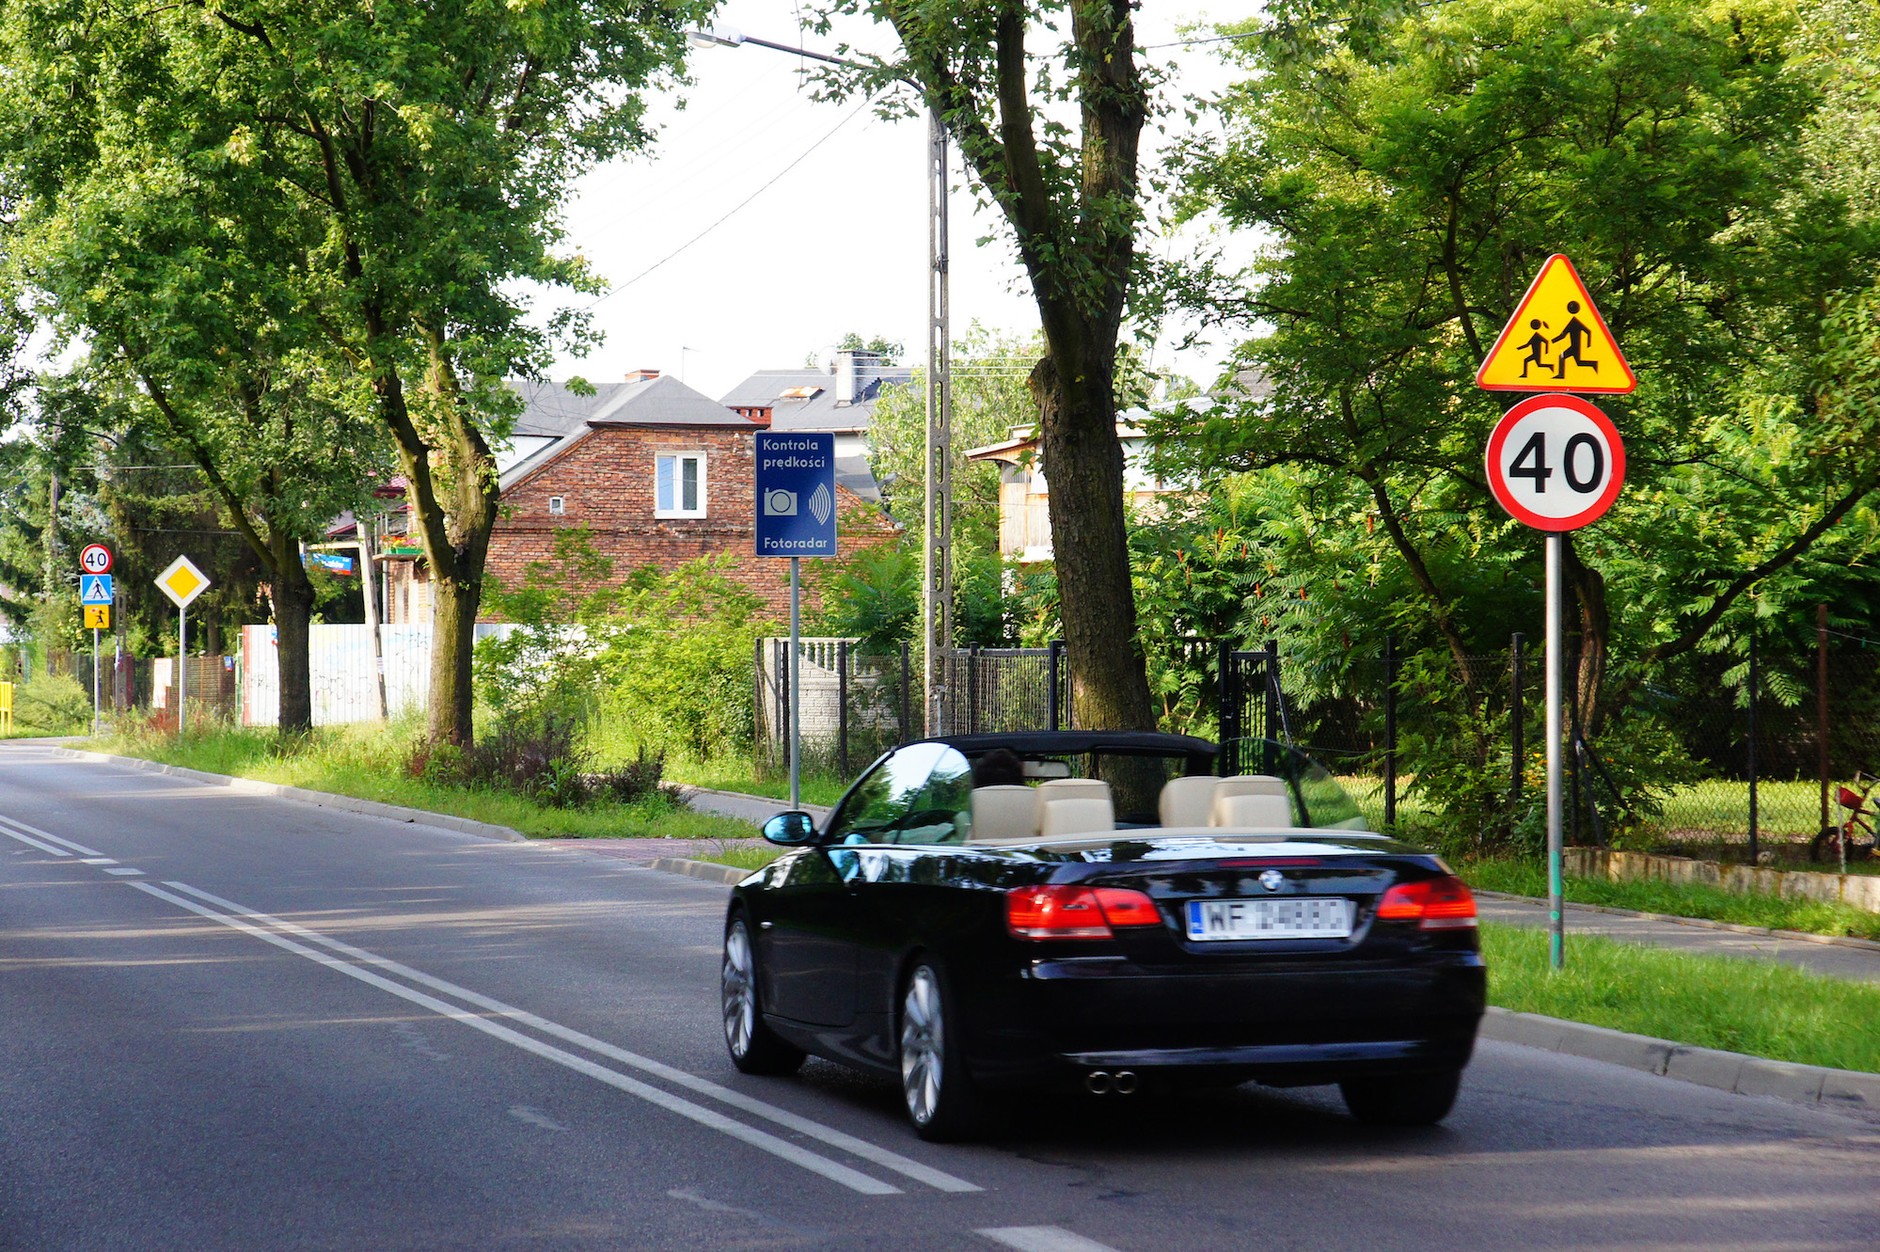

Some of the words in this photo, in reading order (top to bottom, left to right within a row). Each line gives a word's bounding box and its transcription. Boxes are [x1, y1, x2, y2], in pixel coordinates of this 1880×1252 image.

[763, 439, 818, 450] Kontrola
[763, 455, 825, 470] prędkości
[1509, 432, 1604, 493] 40
[764, 537, 827, 549] Fotoradar
[85, 552, 107, 567] 40
